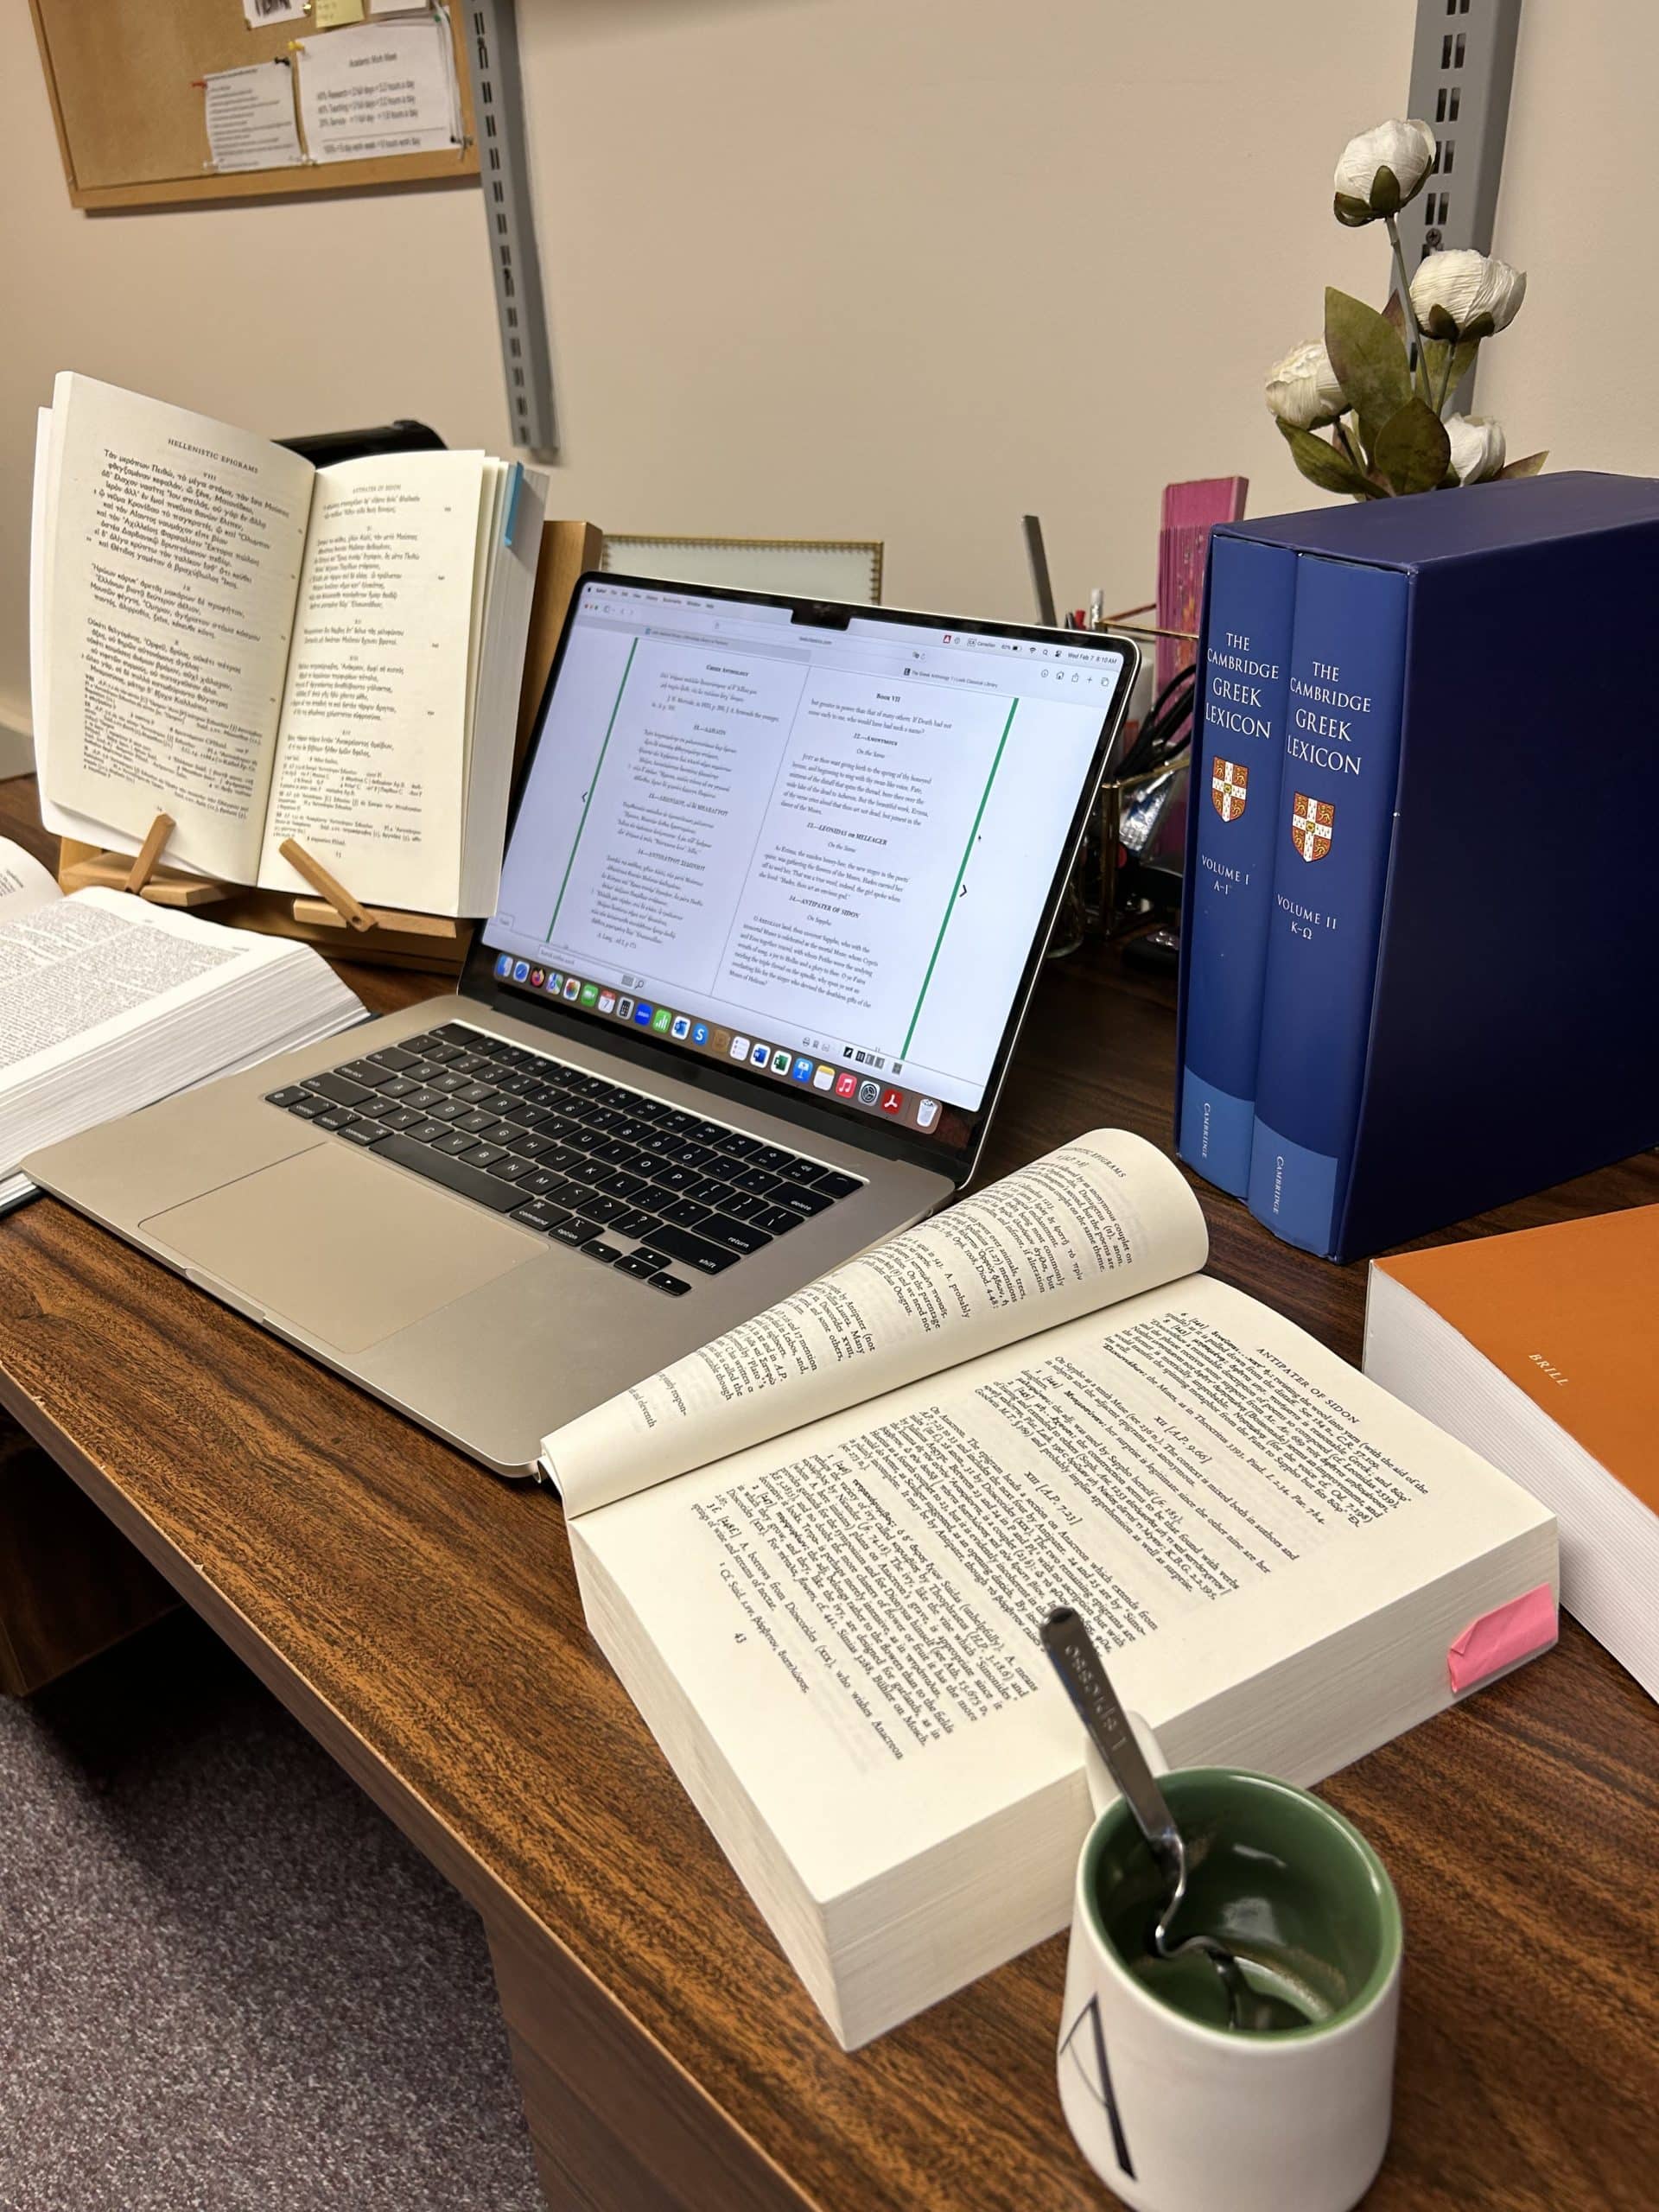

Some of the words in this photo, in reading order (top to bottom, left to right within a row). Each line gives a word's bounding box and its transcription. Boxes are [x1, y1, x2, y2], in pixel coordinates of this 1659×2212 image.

[168, 438, 219, 460] HELLENISTIC
[221, 455, 258, 474] EPIGRAMS
[1226, 632, 1250, 651] THE
[1207, 648, 1279, 679] CAMBRIDGE
[1313, 662, 1339, 683] THE
[1212, 677, 1262, 707] GREEK
[1290, 677, 1371, 713] CAMBRIDGE
[1205, 702, 1272, 739] LEXICON
[1295, 709, 1351, 741] GREEK
[1287, 734, 1362, 776] LEXICON
[1202, 855, 1241, 883] VOLUME
[1245, 874, 1249, 886] I
[1276, 894, 1320, 925] VOLUME
[1327, 916, 1337, 929] II
[696, 1028, 705, 1041] S
[1273, 1156, 1284, 1215] CAMBRIDGE
[728, 1236, 749, 1249] return
[1083, 1206, 1093, 1218] but
[1090, 1219, 1099, 1230] the
[1097, 1231, 1111, 1255] poems
[1090, 1188, 1116, 1222] anonymous
[1115, 1224, 1129, 1251] couplet
[1127, 1253, 1132, 1263] on
[699, 1257, 716, 1268] shift
[1044, 1245, 1065, 1287] commonly
[1084, 1227, 1096, 1244] same
[1093, 1245, 1104, 1272] theme.
[1113, 1245, 1122, 1267] anon.
[999, 1265, 1017, 1303] mentions
[1029, 1256, 1045, 1294] alteration
[948, 1282, 970, 1318] probably
[829, 1334, 843, 1362] others,
[850, 1330, 866, 1354] Many
[1256, 1348, 1309, 1387] ANTIPATER
[1310, 1388, 1325, 1398] OF
[1325, 1399, 1359, 1423] SIDON
[1528, 1354, 1568, 1386] BRILL
[1071, 1380, 1088, 1389] and
[1084, 1389, 1096, 1398] the
[1094, 1397, 1120, 1418] adjacent
[1118, 1416, 1147, 1442] epigrams
[1145, 1441, 1158, 1452] are
[1156, 1452, 1194, 1486] anonymous.
[1163, 1426, 1188, 1445] [A.P.
[1185, 1445, 1212, 1464] 9.66]
[1295, 1396, 1312, 1408] the
[1311, 1405, 1332, 1420] wool
[1327, 1418, 1344, 1430] into
[1340, 1430, 1360, 1445] yarn
[1358, 1442, 1382, 1458] (with
[1380, 1457, 1394, 1468] the
[1392, 1467, 1408, 1477] aid
[1414, 1482, 1428, 1494] the
[1106, 1398, 1128, 1414] Muse
[1125, 1413, 1141, 1424] (see
[1162, 1443, 1178, 1457] The
[1176, 1456, 1203, 1478] context
[1206, 1483, 1233, 1503] mixed
[1229, 1500, 1248, 1517] both
[1245, 1516, 1255, 1524] in
[1254, 1524, 1282, 1548] authors
[1281, 1548, 1300, 1560] and
[1034, 1484, 1060, 1504] [A.P.
[1057, 1504, 1083, 1525] 7.23]
[1104, 1425, 1117, 1436] her
[1116, 1437, 1141, 1459] surprise
[1145, 1462, 1179, 1492] legitimate
[1177, 1492, 1196, 1508] since
[1194, 1507, 1208, 1518] the
[1207, 1518, 1228, 1535] other
[1226, 1535, 1243, 1549] nine
[1243, 1550, 1255, 1560] are
[1255, 1560, 1270, 1573] her
[967, 1437, 979, 1450] The
[978, 1451, 1002, 1474] epigram
[998, 1473, 1021, 1491] heads
[1021, 1497, 1047, 1519] section
[1047, 1520, 1058, 1529] on
[1058, 1531, 1089, 1561] Anacreon
[1090, 1562, 1112, 1583] which
[1111, 1584, 1138, 1610] extends
[1138, 1611, 1157, 1630] from
[734, 1632, 747, 1644] 43
